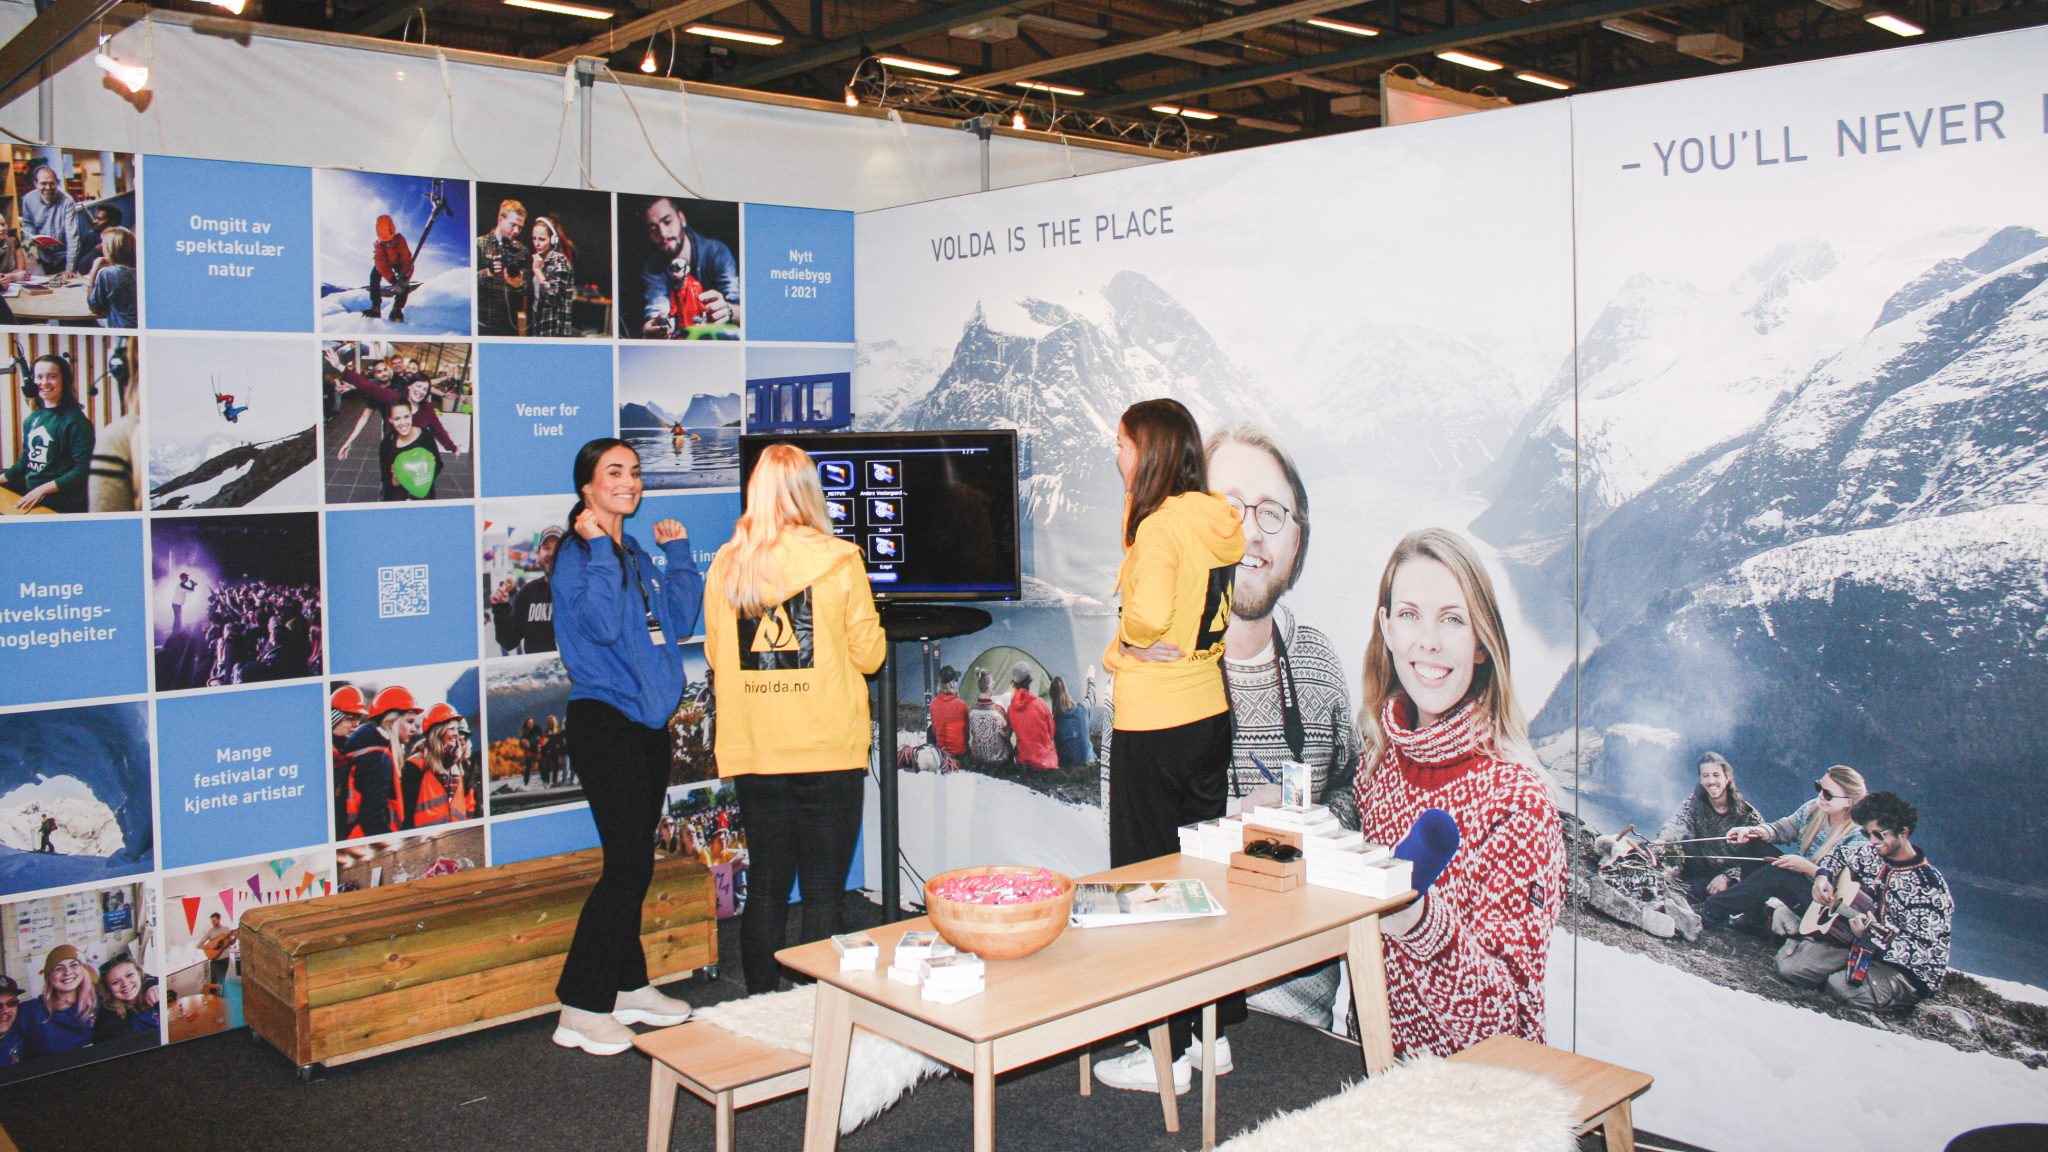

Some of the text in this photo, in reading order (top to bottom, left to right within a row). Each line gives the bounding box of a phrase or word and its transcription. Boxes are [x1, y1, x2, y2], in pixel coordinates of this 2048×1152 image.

[1836, 99, 2006, 157] NEVER
[189, 214, 272, 236] Omgitt av
[930, 205, 1174, 262] VOLDA IS THE PLACE
[175, 238, 286, 257] spektakulær
[788, 248, 814, 265] Nytt
[207, 262, 255, 278] natur
[770, 267, 832, 284] mediebygg
[784, 285, 817, 299] i 2021
[514, 402, 580, 417] Vener for
[532, 422, 564, 437] livet
[20, 582, 84, 600] Mange
[0, 603, 112, 624] tvekslings-
[744, 680, 811, 694] hivolda.no
[216, 745, 273, 764] Mange
[193, 764, 299, 789] festivalar og
[184, 784, 306, 815] kjente artistar
